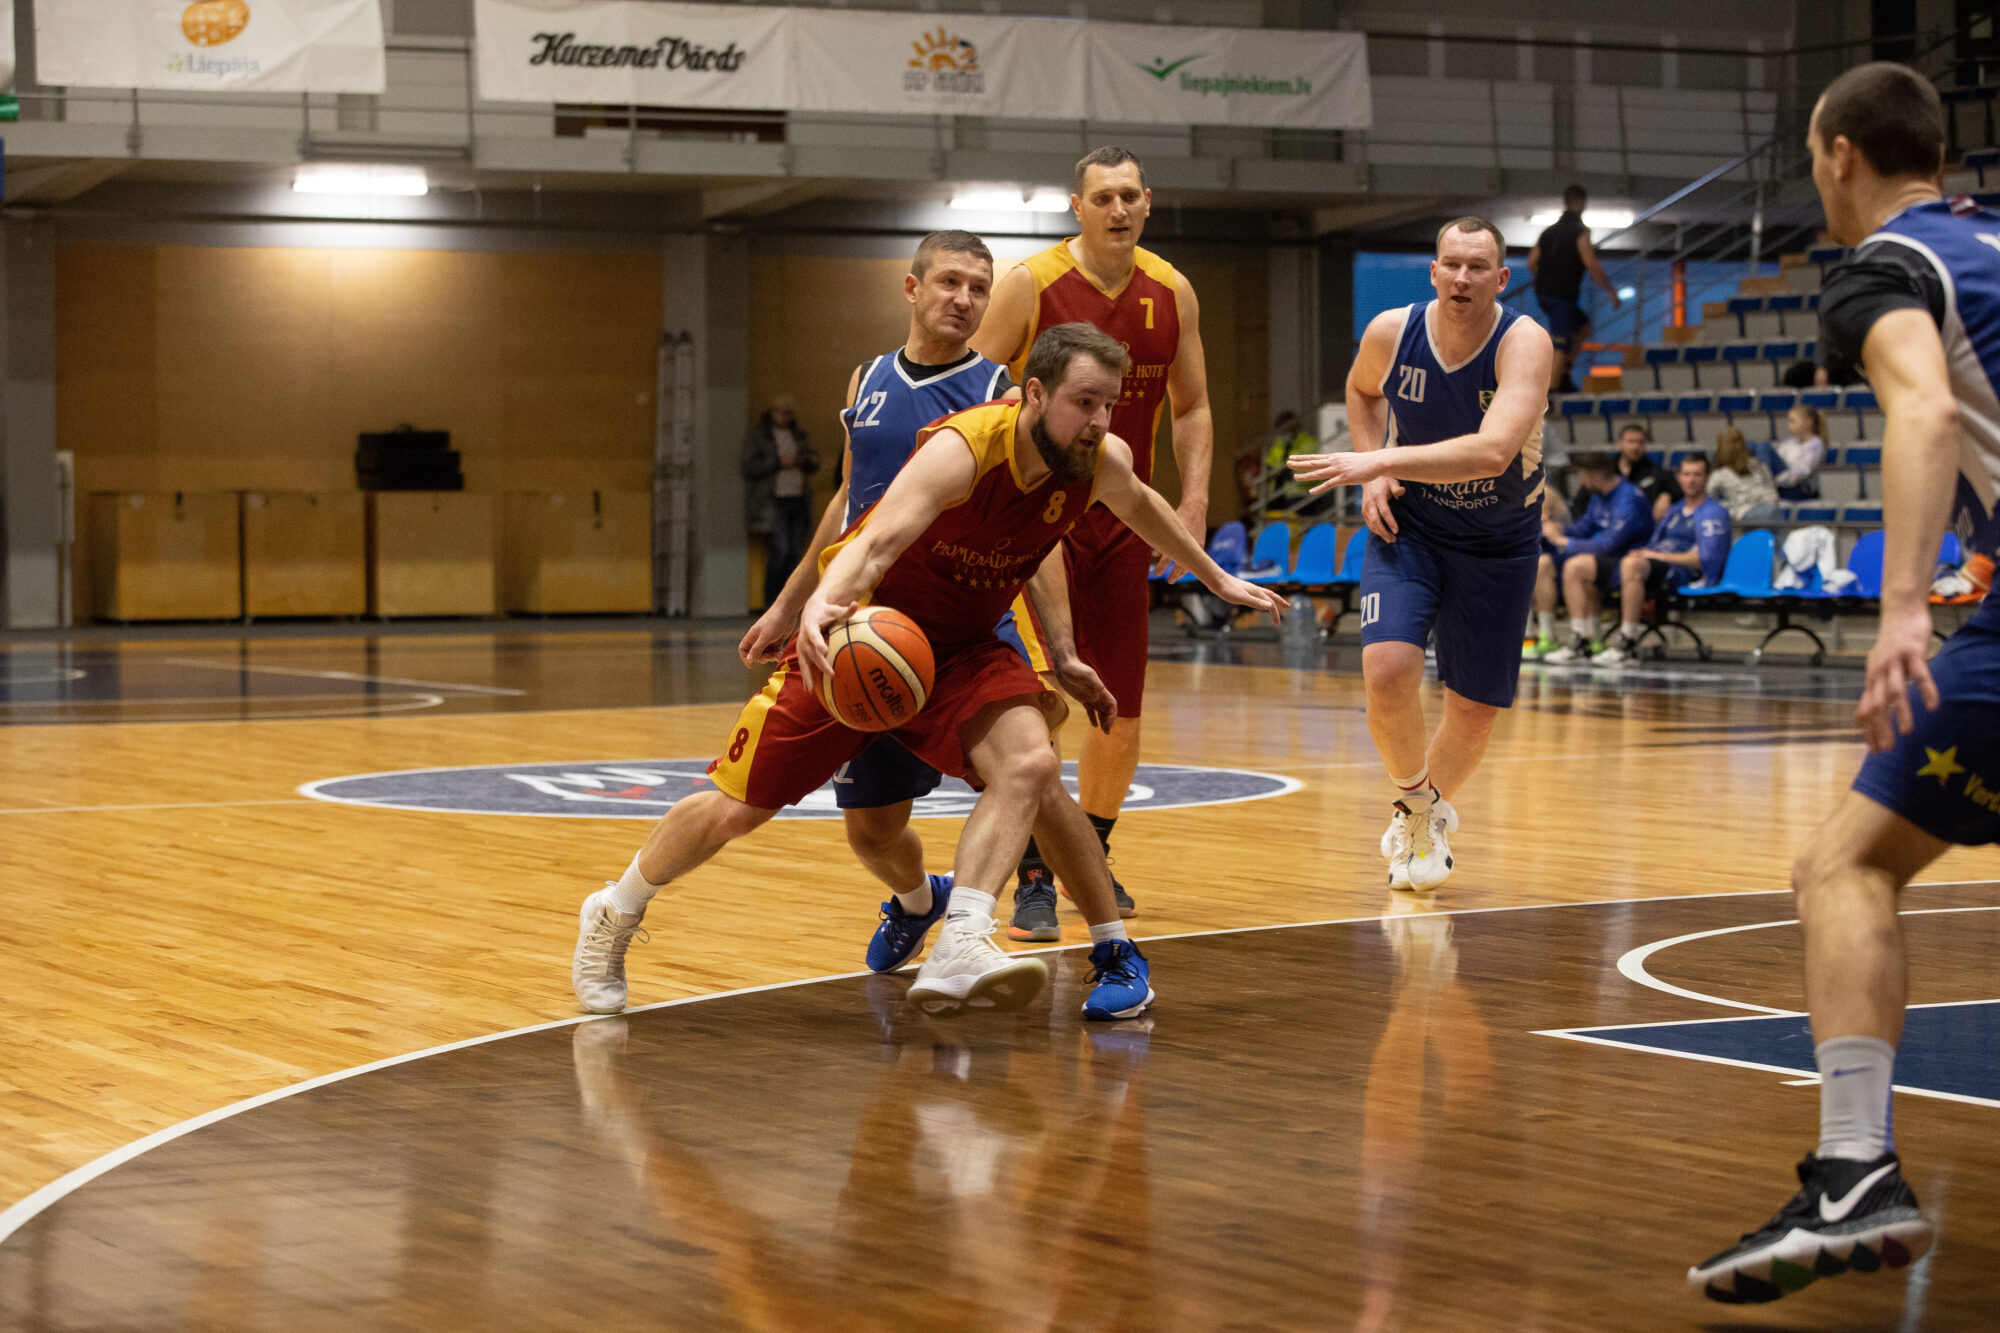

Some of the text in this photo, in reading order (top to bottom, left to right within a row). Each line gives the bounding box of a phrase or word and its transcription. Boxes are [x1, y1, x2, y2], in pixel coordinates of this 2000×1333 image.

[530, 33, 657, 68] Kurzemes
[1139, 297, 1154, 329] 7
[1397, 365, 1427, 403] 20
[1043, 490, 1066, 524] 8
[1360, 592, 1380, 629] 20
[729, 727, 749, 763] 8
